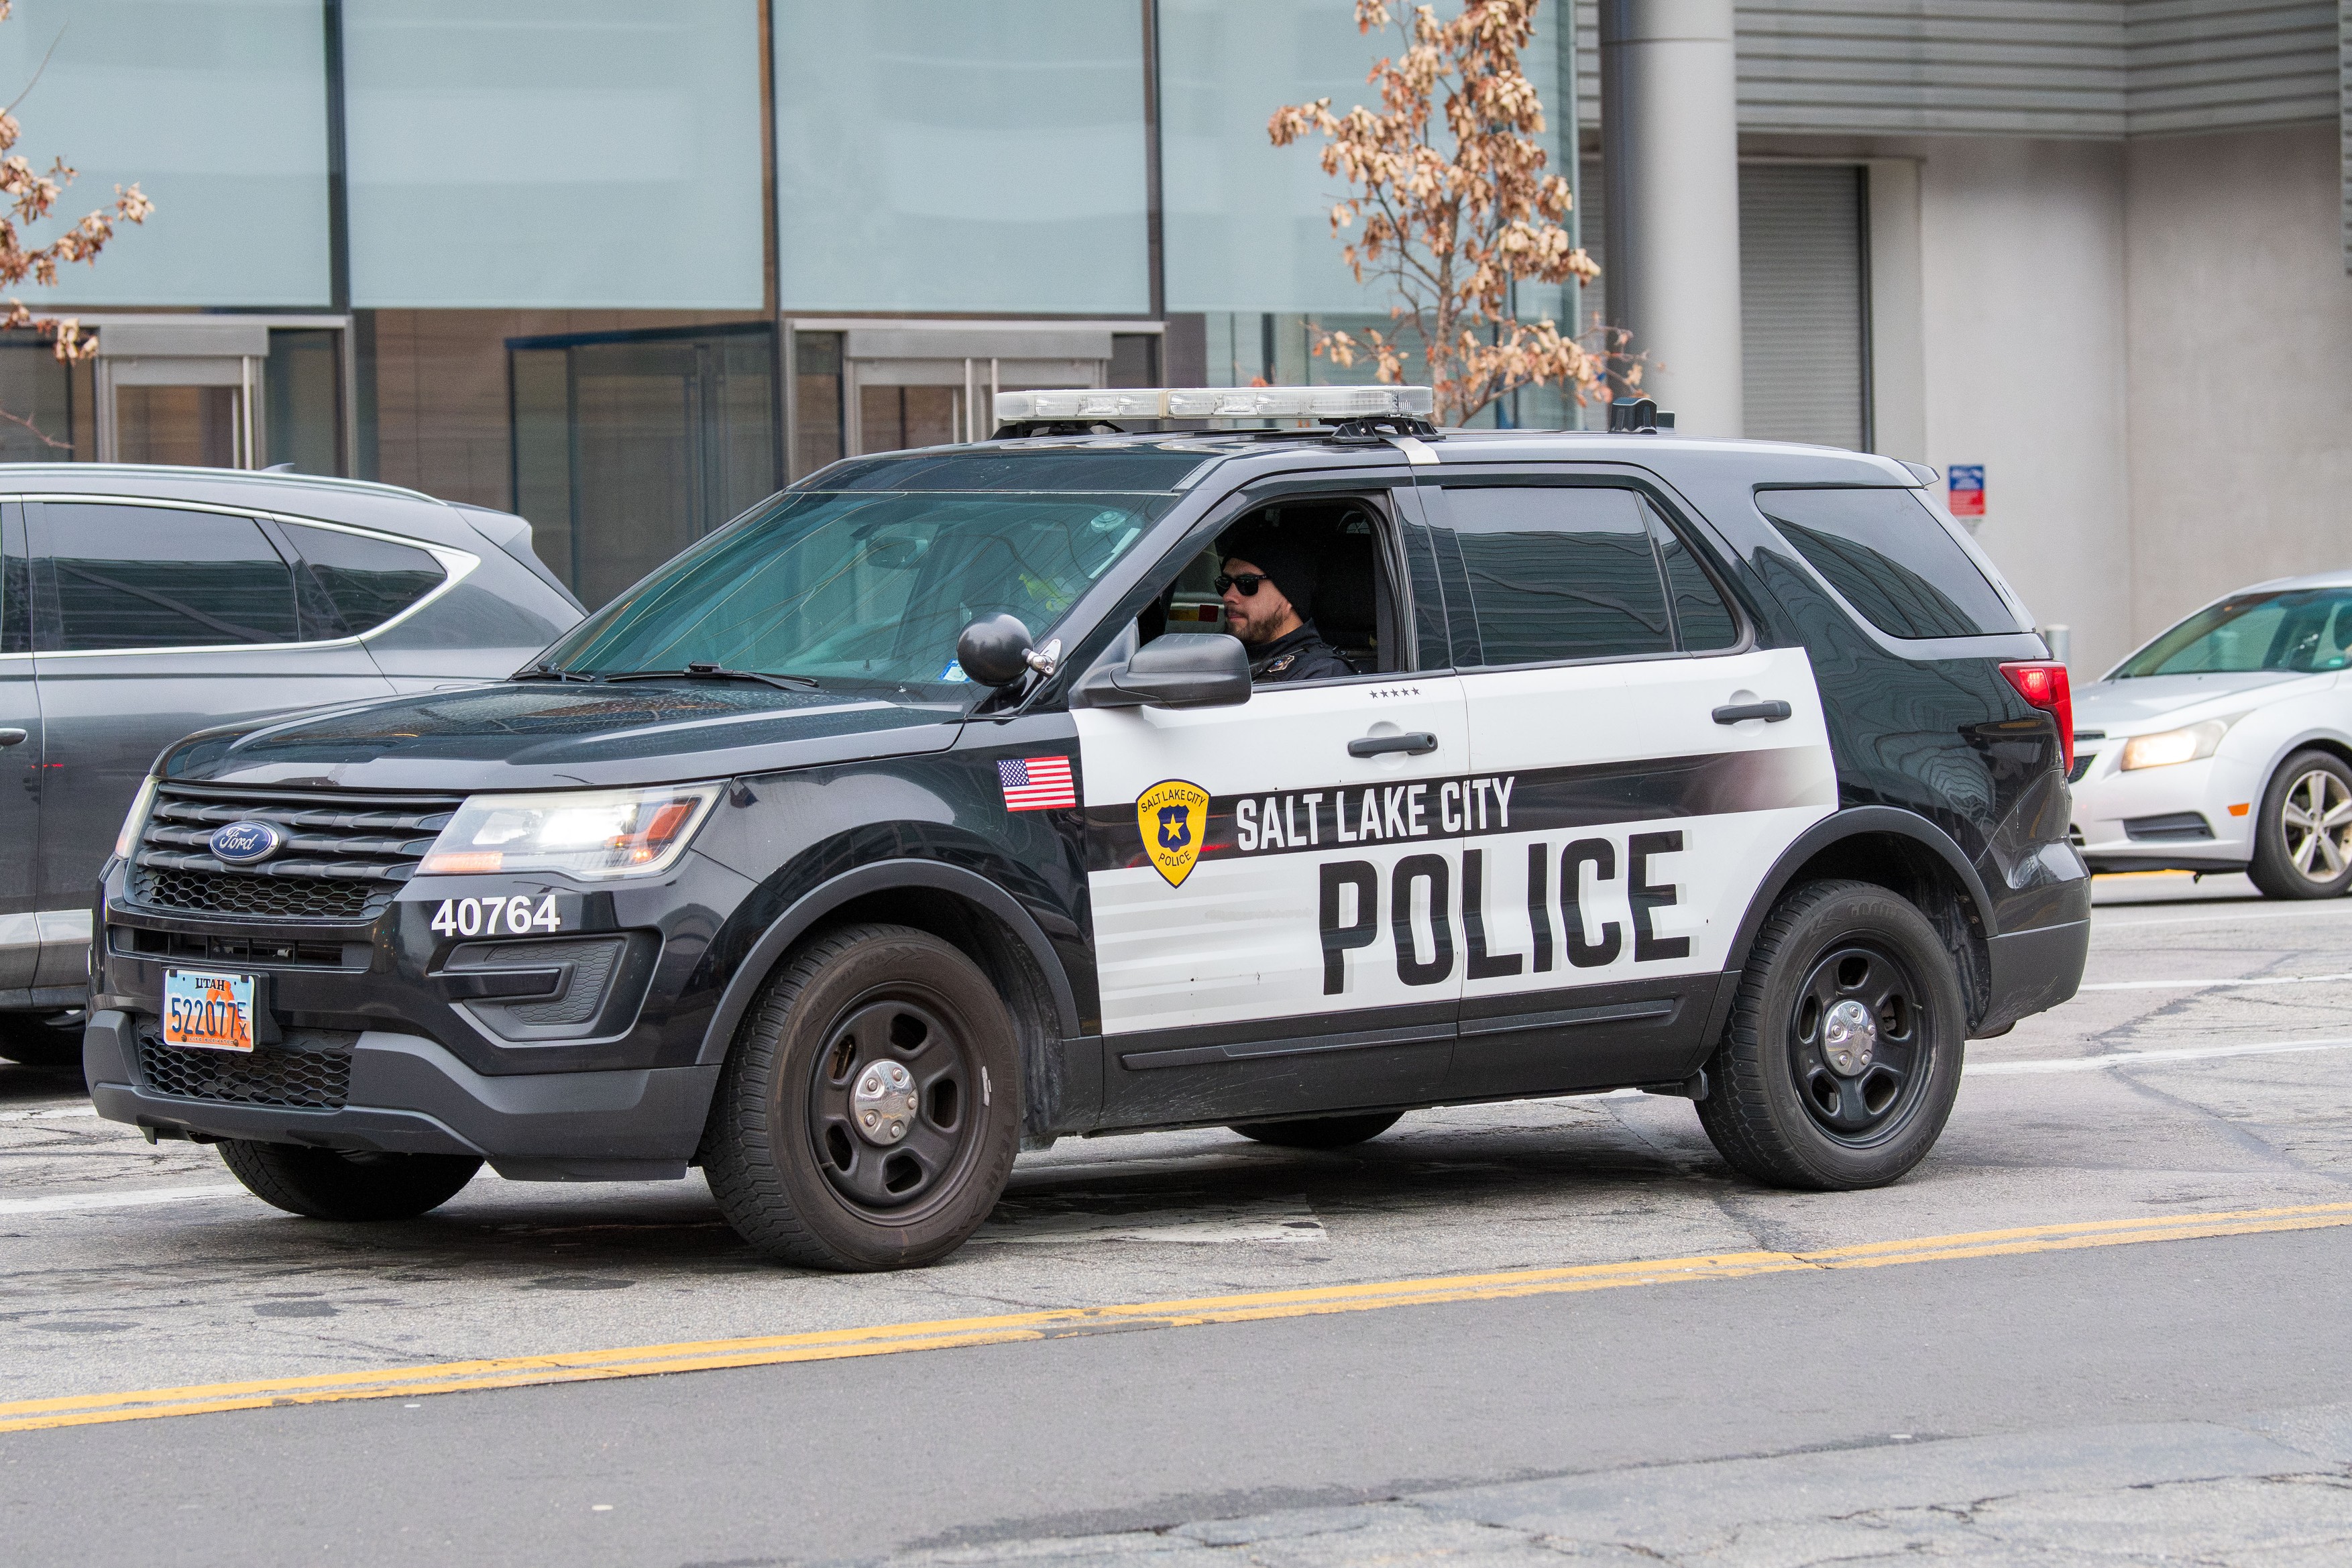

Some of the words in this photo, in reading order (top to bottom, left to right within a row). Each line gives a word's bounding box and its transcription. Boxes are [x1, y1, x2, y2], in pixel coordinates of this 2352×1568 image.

[1141, 793, 1162, 813] SALT
[1162, 789, 1186, 801] LAKE
[1186, 791, 1206, 807] CITY
[1236, 793, 1323, 851] SALT
[1336, 783, 1429, 842] LAKE
[1441, 776, 1515, 832] CITY
[219, 826, 259, 850] Ford
[1158, 850, 1192, 866] POLICE
[431, 894, 561, 937] 40764
[1319, 830, 1691, 995] POLICE
[194, 977, 225, 991] UTAH
[172, 997, 235, 1038] 522077
